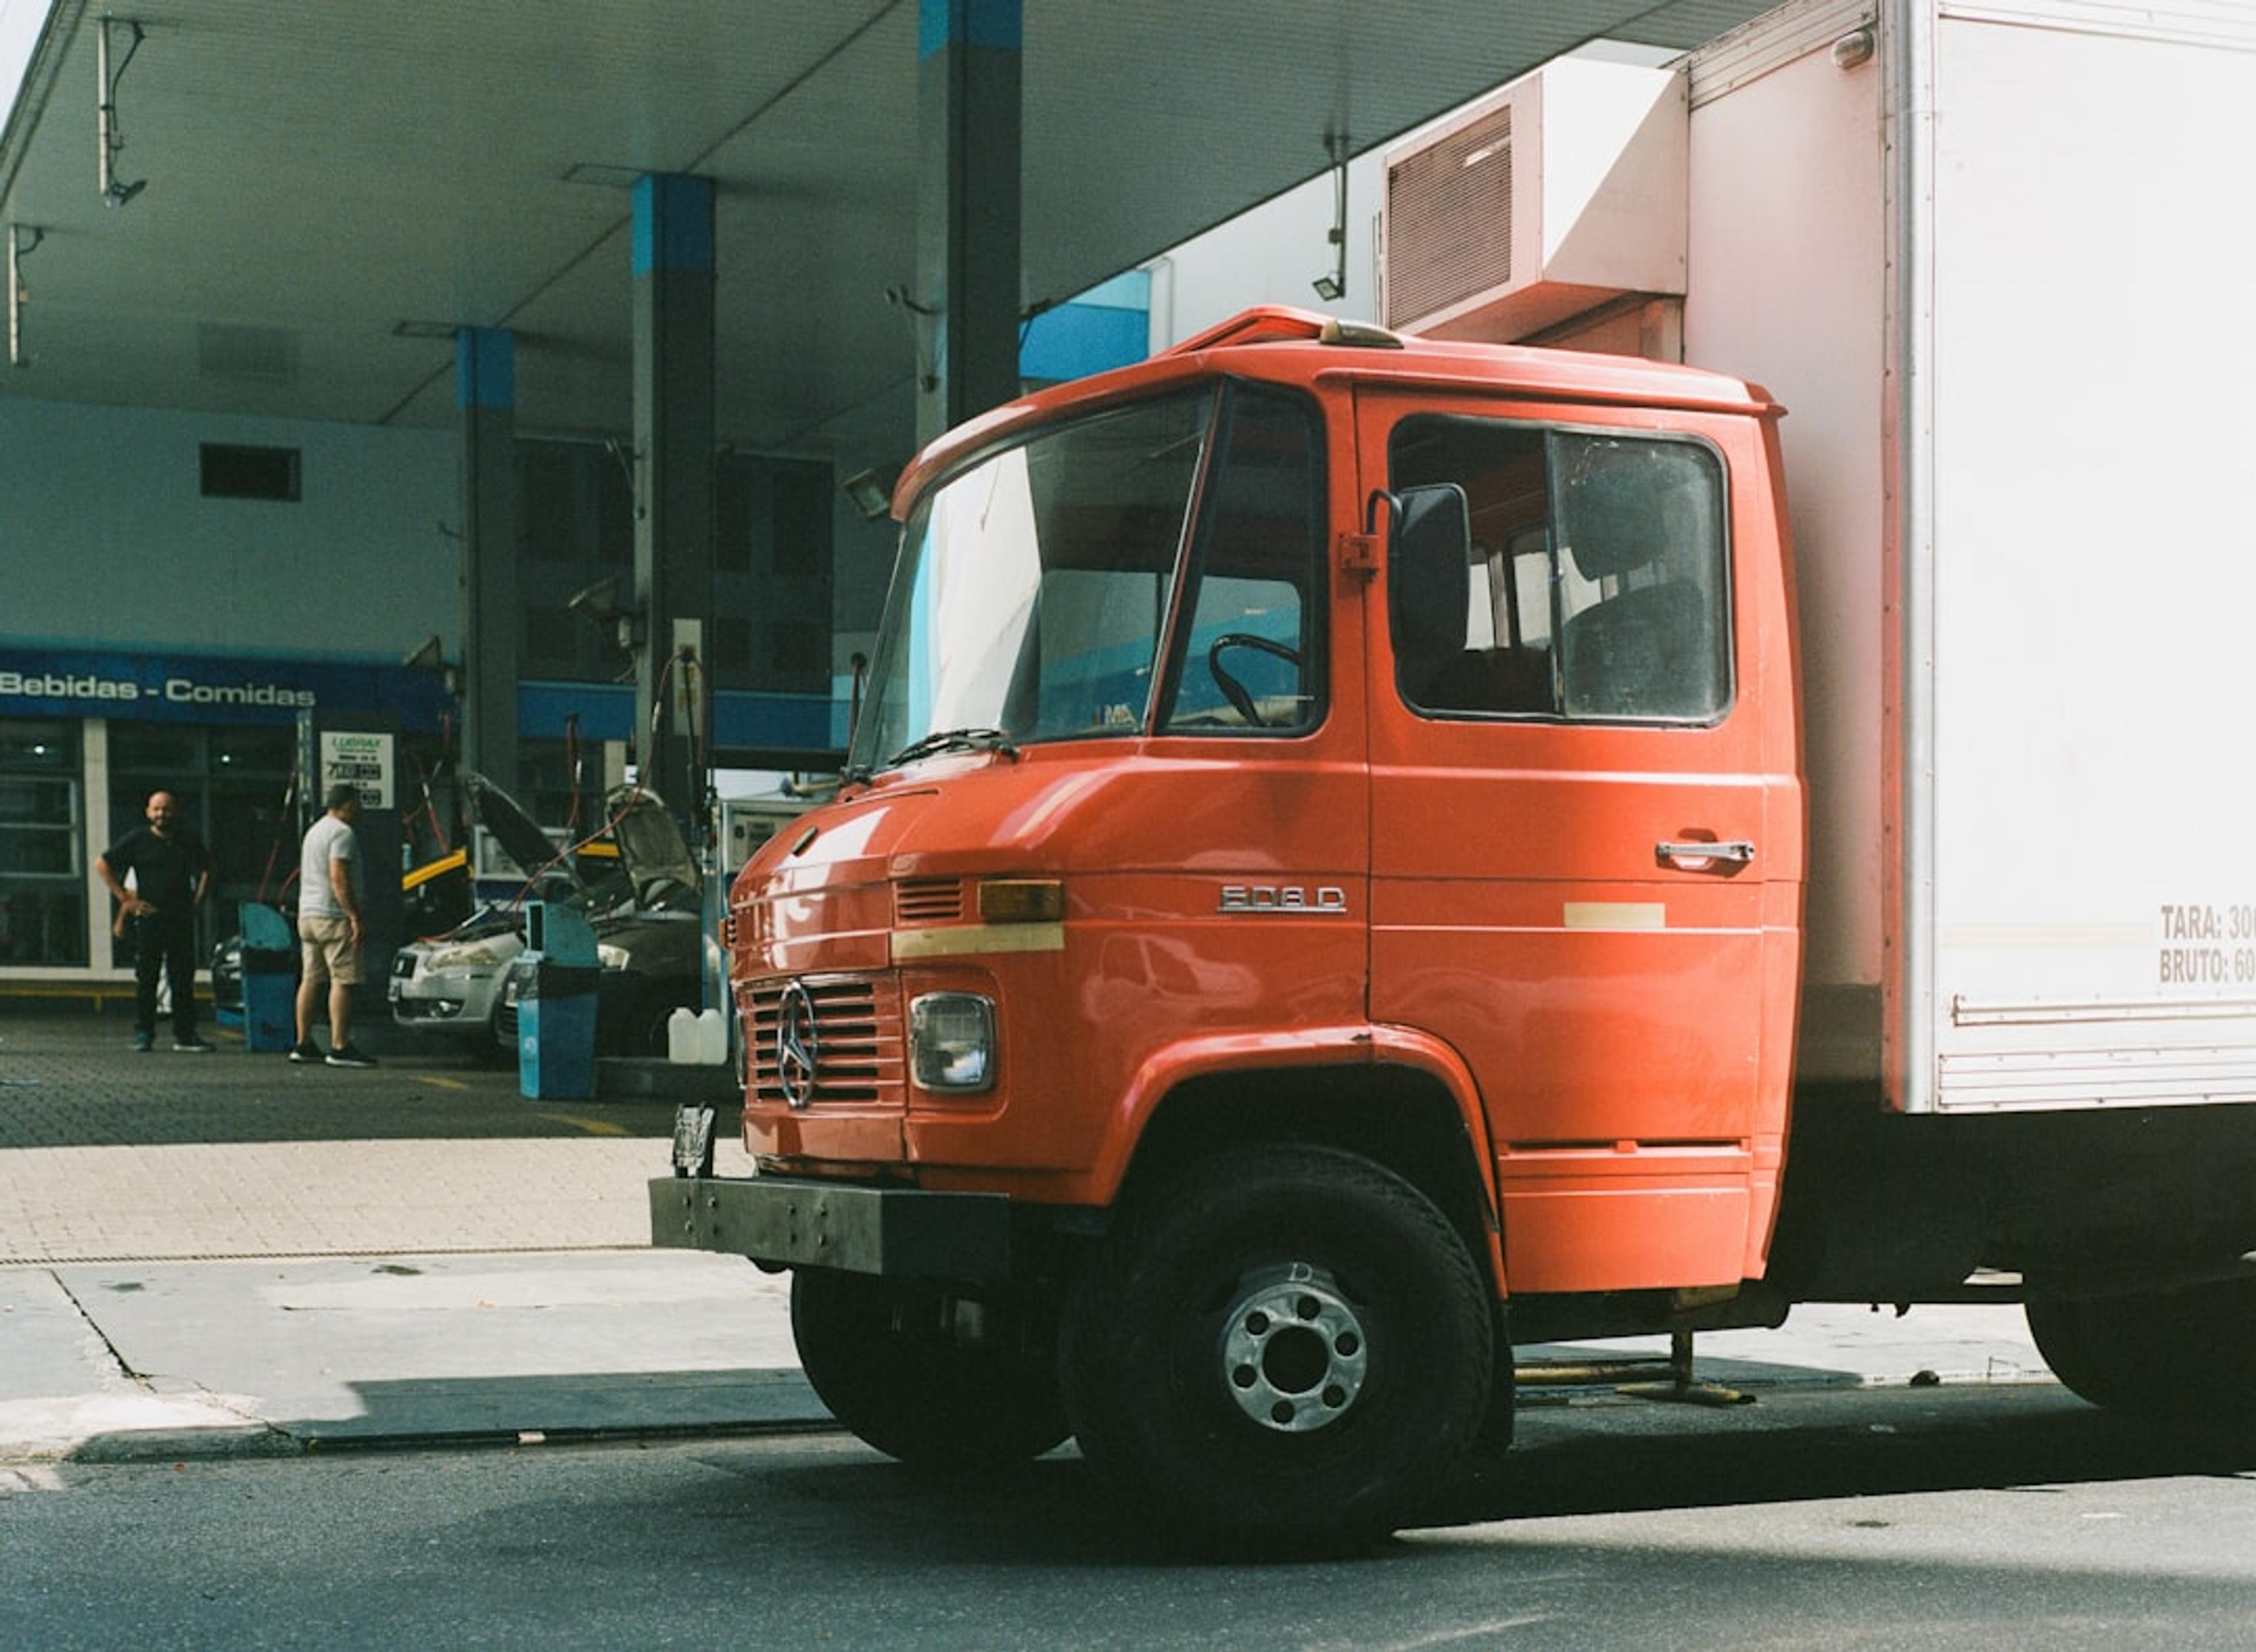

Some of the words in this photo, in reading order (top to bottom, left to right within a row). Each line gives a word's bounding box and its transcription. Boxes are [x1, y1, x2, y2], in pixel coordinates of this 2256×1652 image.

[0, 671, 139, 700] Bebidas
[166, 679, 316, 707] Comidas
[2161, 905, 2221, 939] TARA:
[2228, 904, 2256, 939] 30
[2160, 948, 2228, 983] BRUTO:
